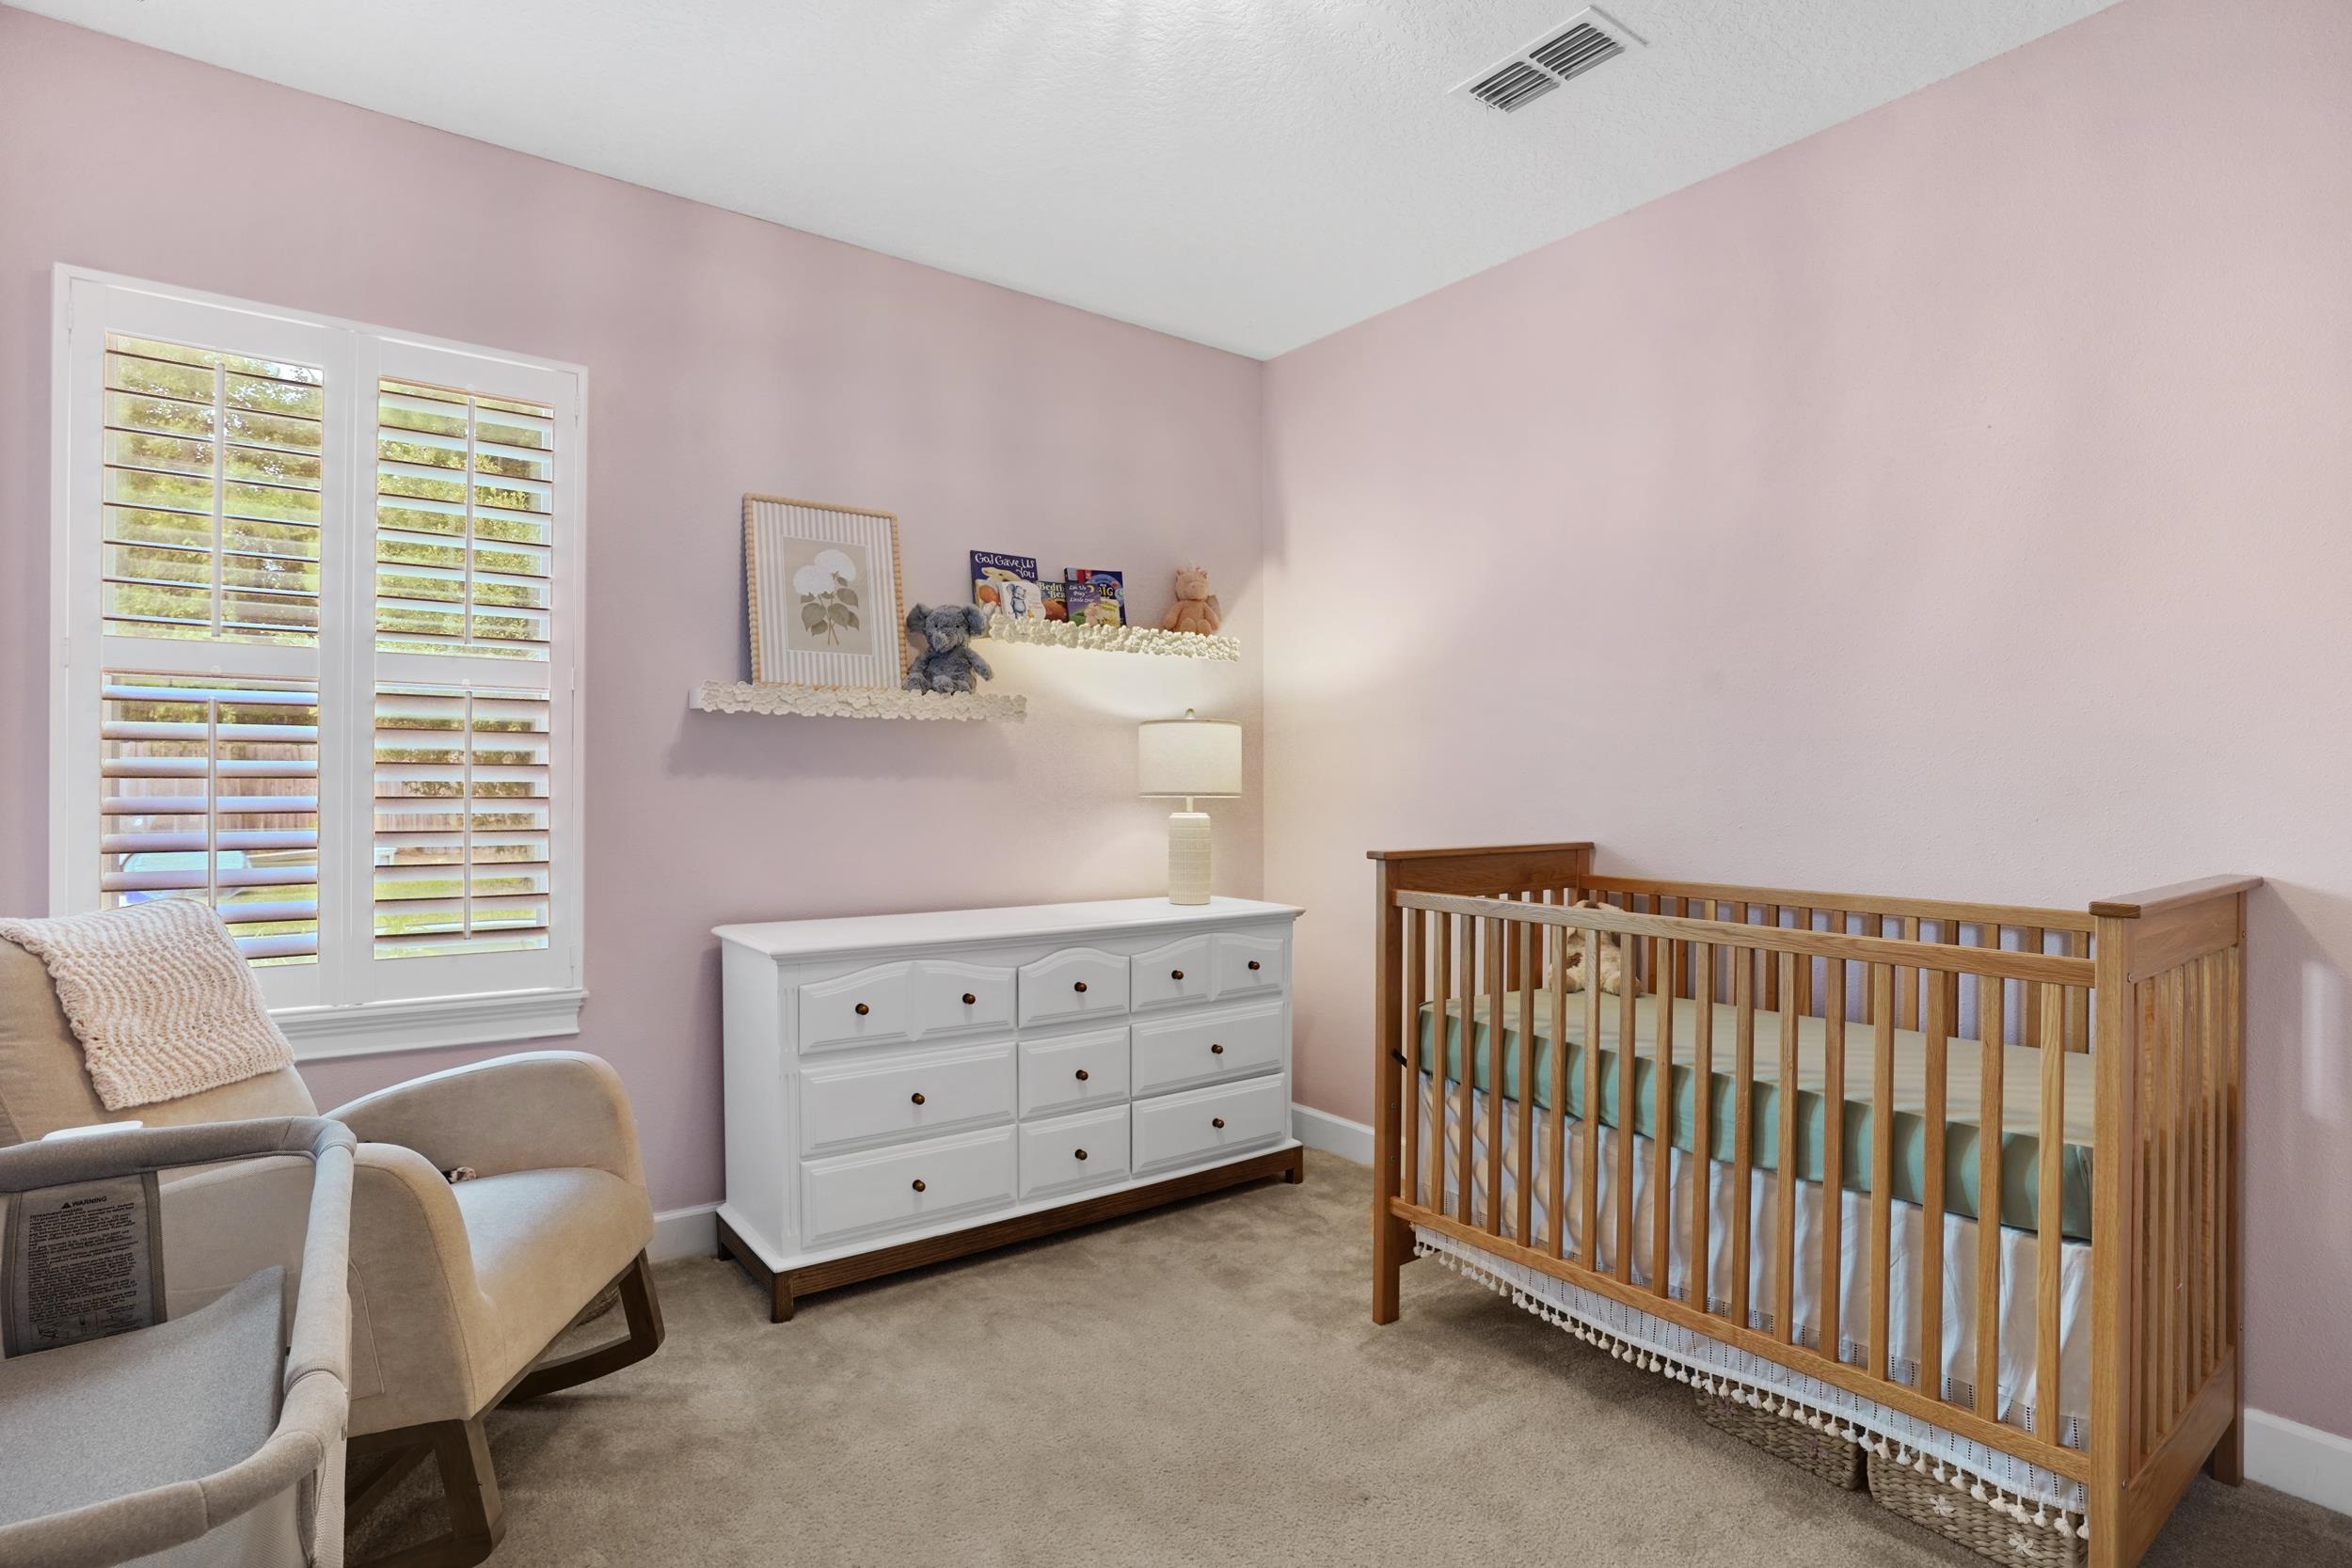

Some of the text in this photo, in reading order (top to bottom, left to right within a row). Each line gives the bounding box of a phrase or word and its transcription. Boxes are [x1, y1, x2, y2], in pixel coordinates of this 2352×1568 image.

[975, 553, 1035, 568] God Gave Us
[1016, 566, 1035, 578] You
[1047, 591, 1065, 599] Bea
[72, 1196, 107, 1206] WARNING
